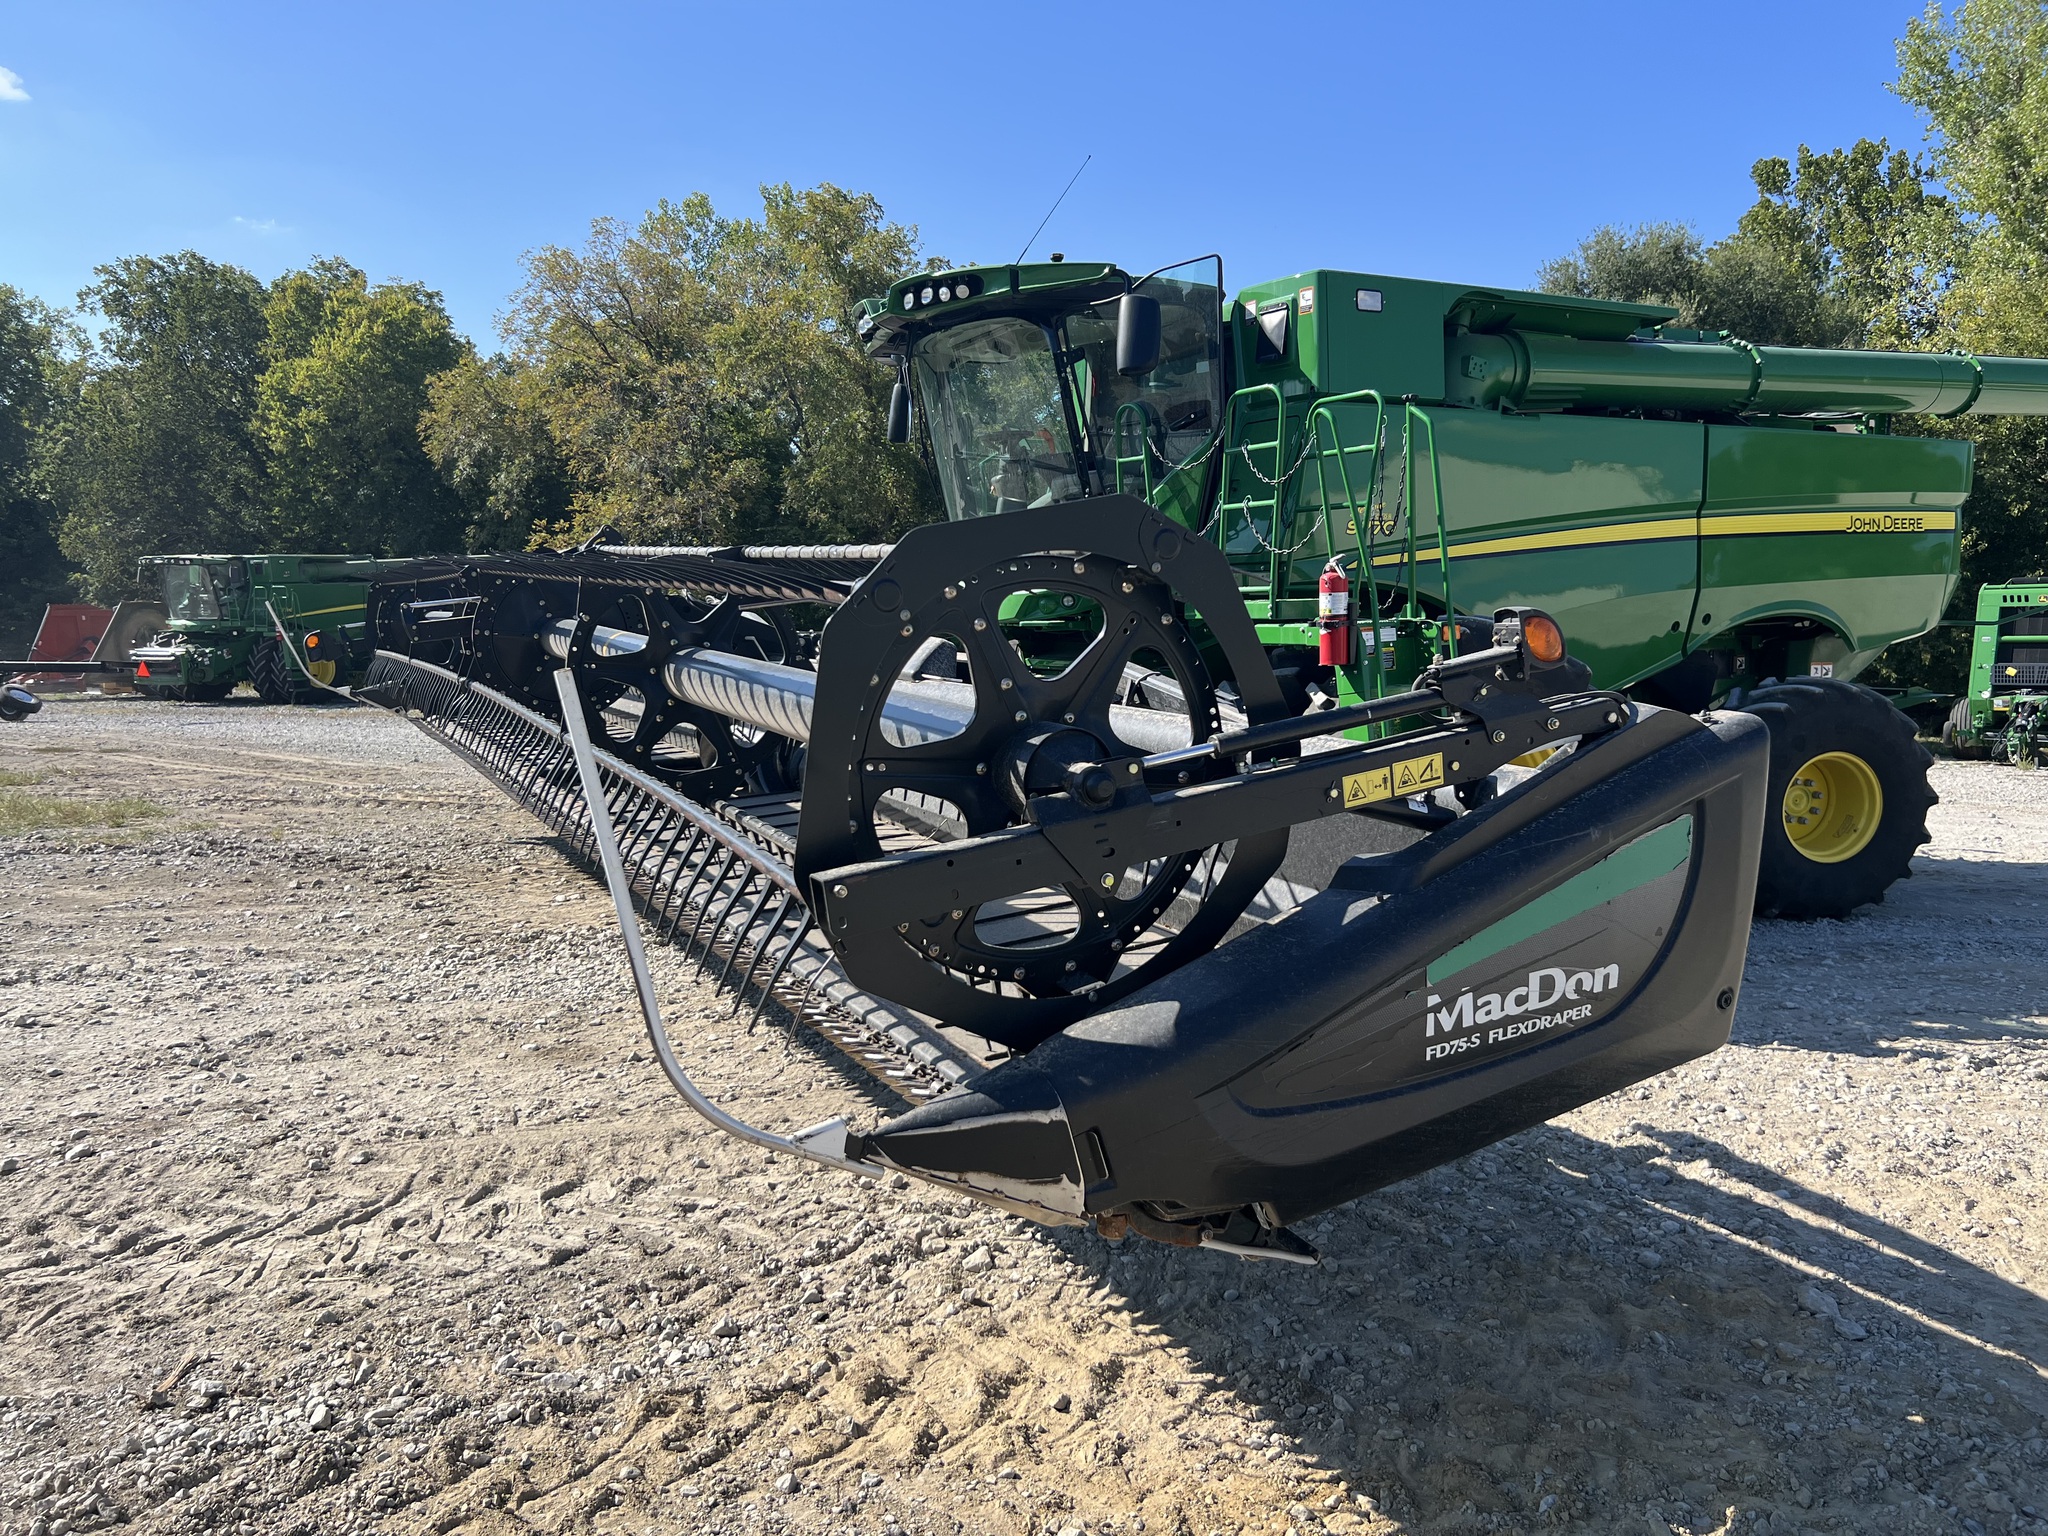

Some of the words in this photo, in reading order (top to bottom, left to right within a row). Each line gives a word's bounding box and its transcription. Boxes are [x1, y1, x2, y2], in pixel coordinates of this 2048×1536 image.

[1345, 519, 1395, 536] S70
[1846, 515, 1881, 530] JOHN
[1884, 515, 1924, 530] DEERE
[1426, 963, 1619, 1037] MacDon
[1426, 1033, 1480, 1061] FD75-S
[1488, 1004, 1592, 1044] FLEXDRAPER
